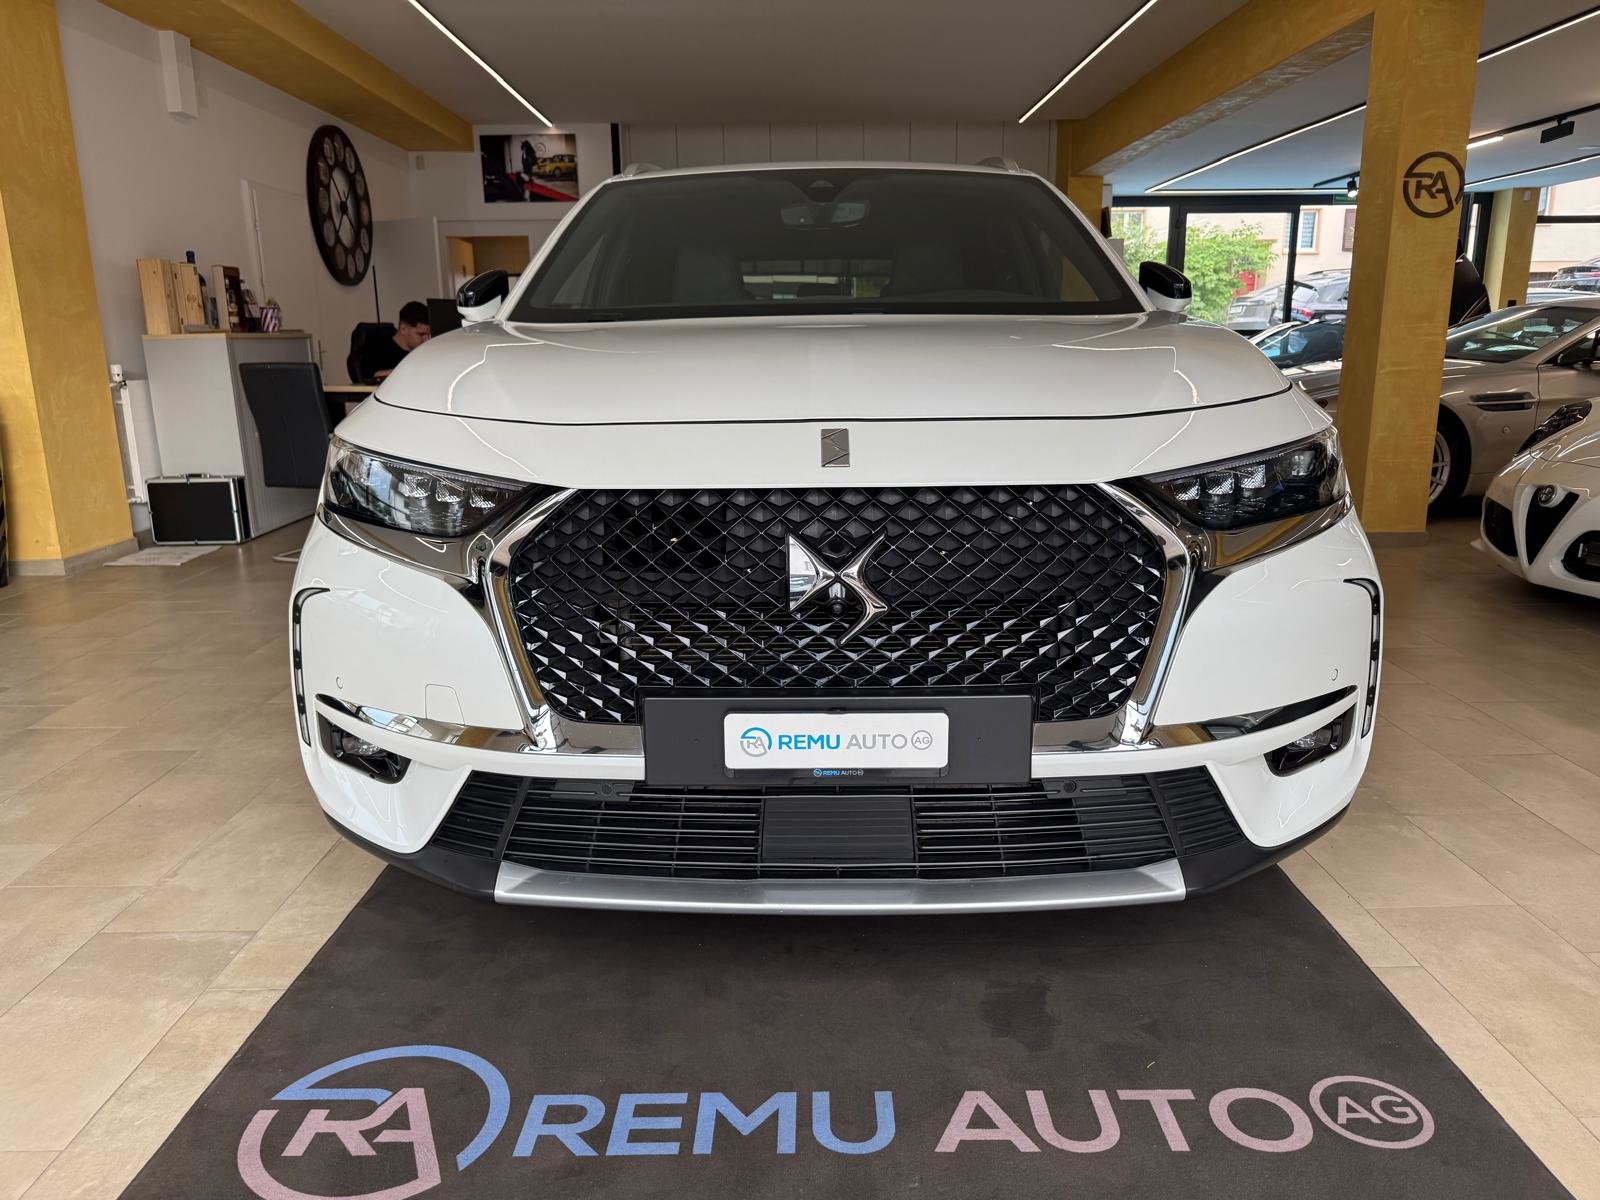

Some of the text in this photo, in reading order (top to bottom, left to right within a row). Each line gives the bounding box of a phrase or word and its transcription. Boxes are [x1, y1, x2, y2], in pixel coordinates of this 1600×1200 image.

[778, 734, 841, 750] REMU
[846, 734, 908, 750] AUTO
[512, 1090, 896, 1157] REMU
[934, 1088, 1314, 1154] AUTO
[1337, 1095, 1418, 1125] AG
